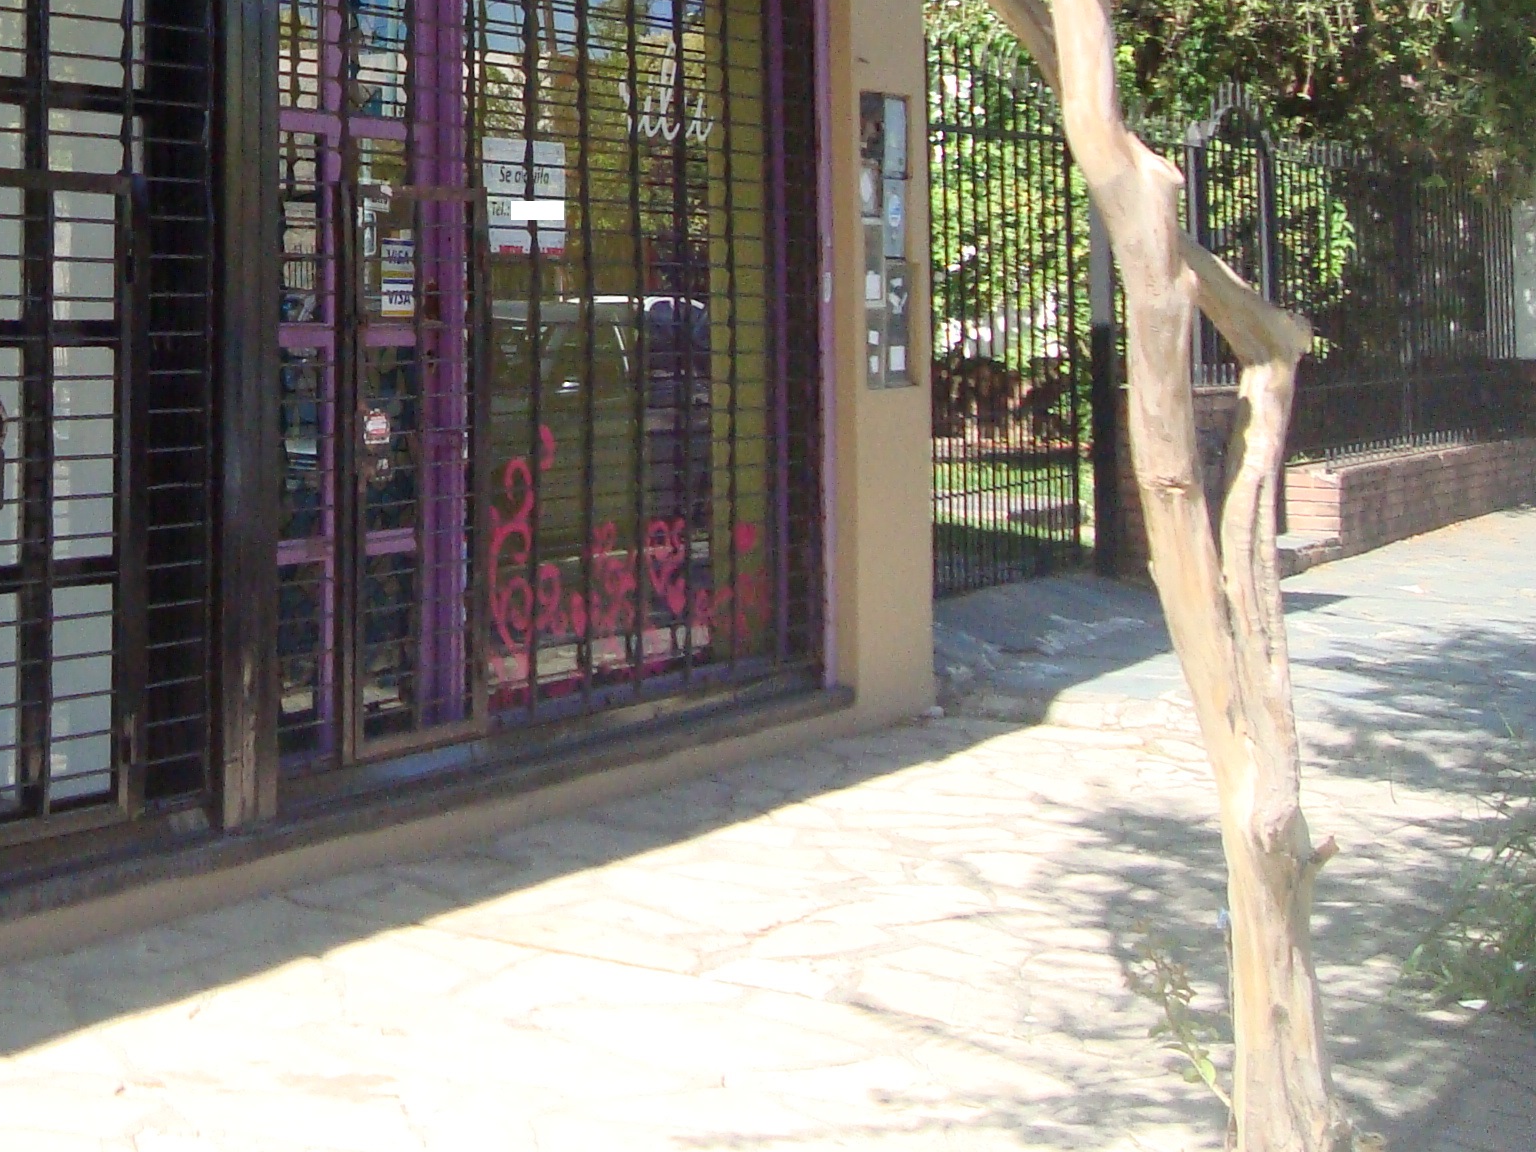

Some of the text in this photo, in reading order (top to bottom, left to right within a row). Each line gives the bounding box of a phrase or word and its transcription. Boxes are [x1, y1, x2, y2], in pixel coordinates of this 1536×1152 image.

[498, 166, 550, 185] Se auila
[385, 249, 410, 265] VISA
[385, 289, 412, 305] VISA
